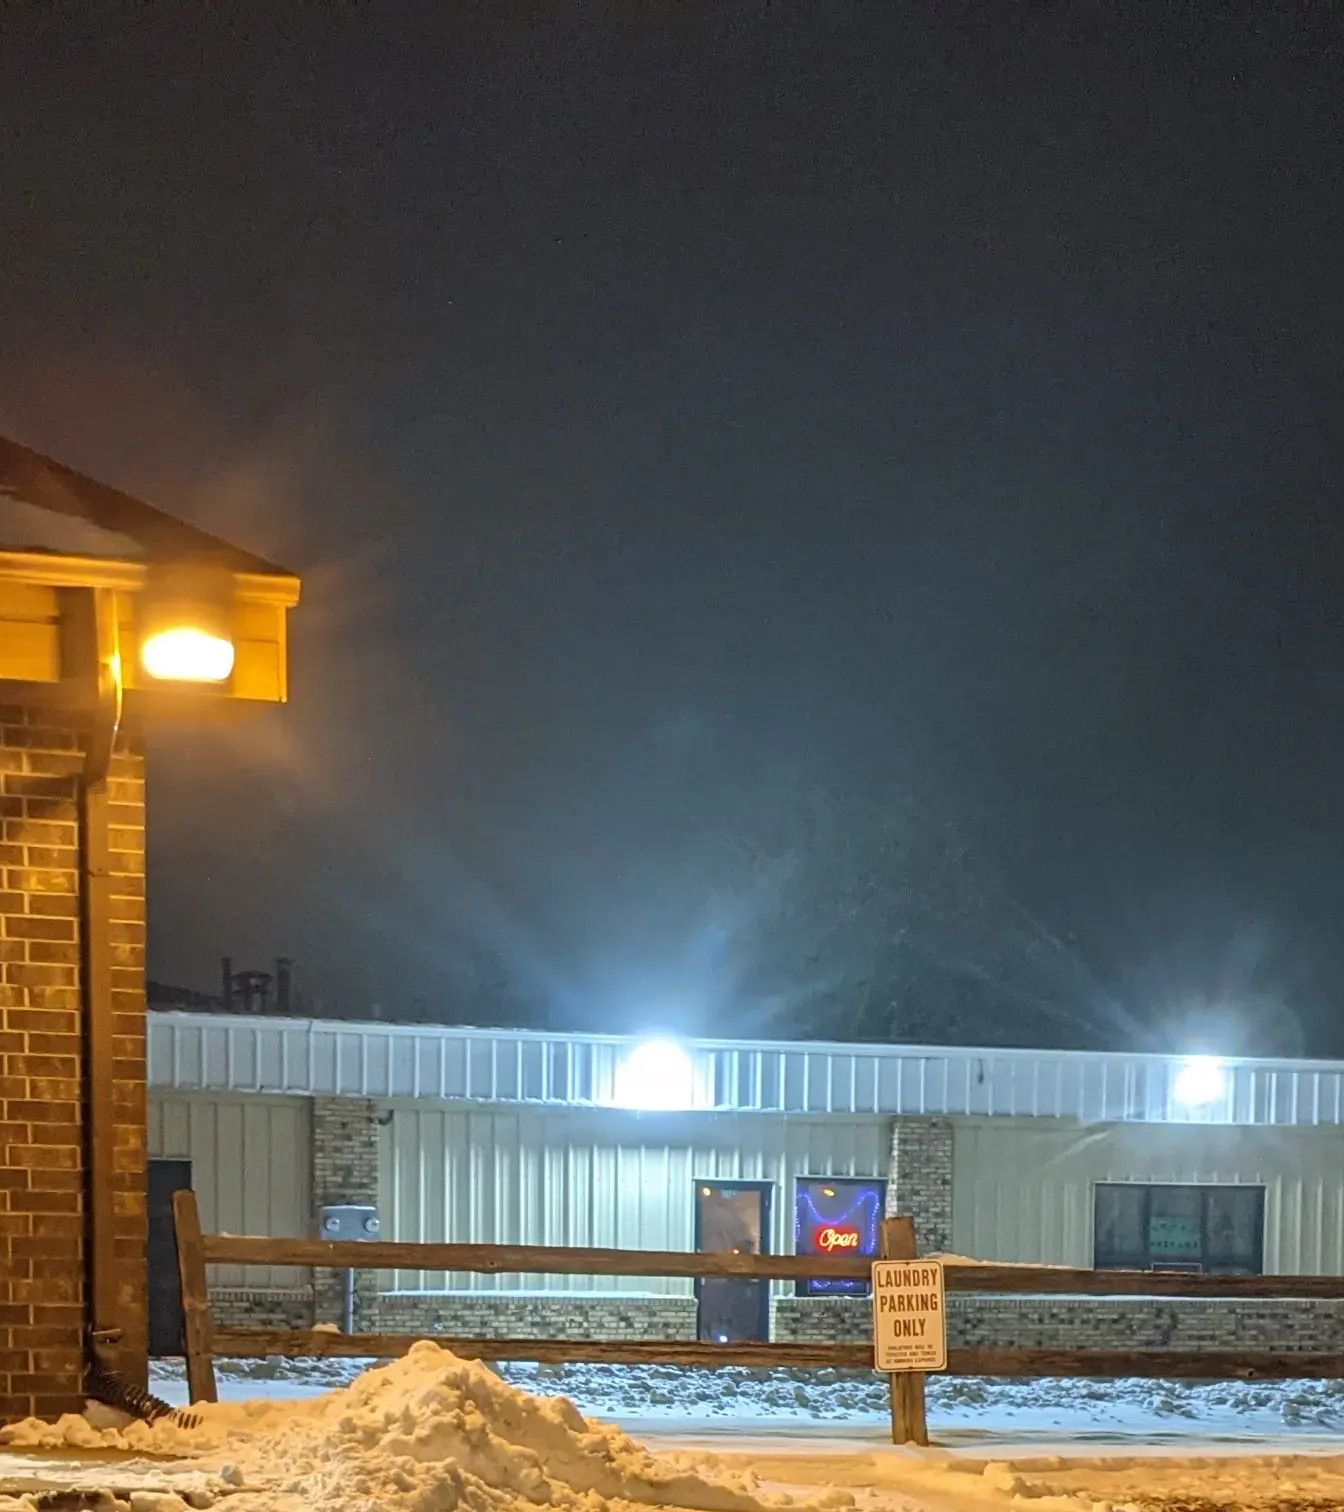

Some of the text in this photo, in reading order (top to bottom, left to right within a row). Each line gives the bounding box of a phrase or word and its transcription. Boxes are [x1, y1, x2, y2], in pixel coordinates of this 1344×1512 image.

[819, 1228, 858, 1252] Open
[877, 1269, 938, 1288] LAUNDRY
[880, 1293, 939, 1313] PARKING
[893, 1318, 927, 1338] ONLY
